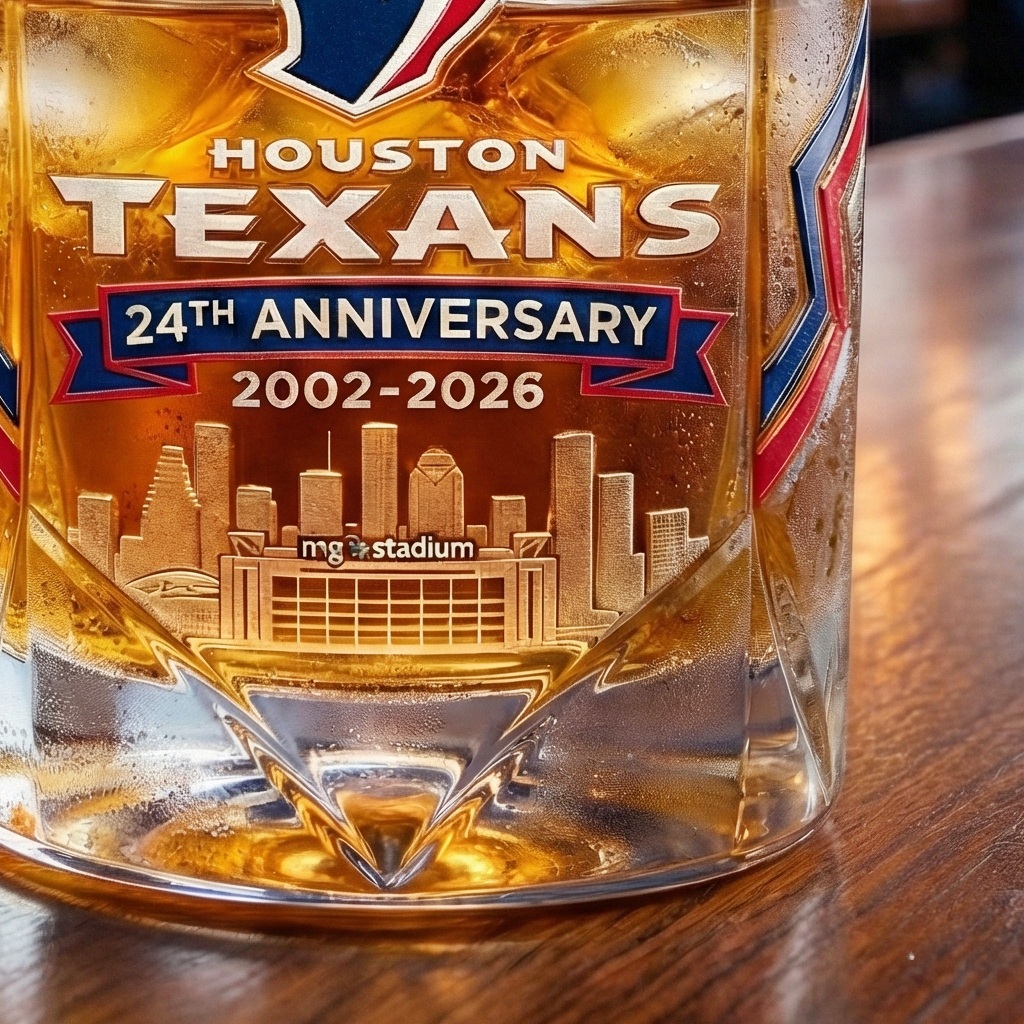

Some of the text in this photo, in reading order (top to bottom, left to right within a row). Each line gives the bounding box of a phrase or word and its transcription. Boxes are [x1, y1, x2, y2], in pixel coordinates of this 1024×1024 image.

[209, 138, 567, 173] HOUSTON
[48, 175, 723, 262] TEXANS
[124, 297, 659, 347] 24TH ANNIVERSARY
[231, 369, 545, 410] 2002-2026
[372, 536, 475, 560] stadium
